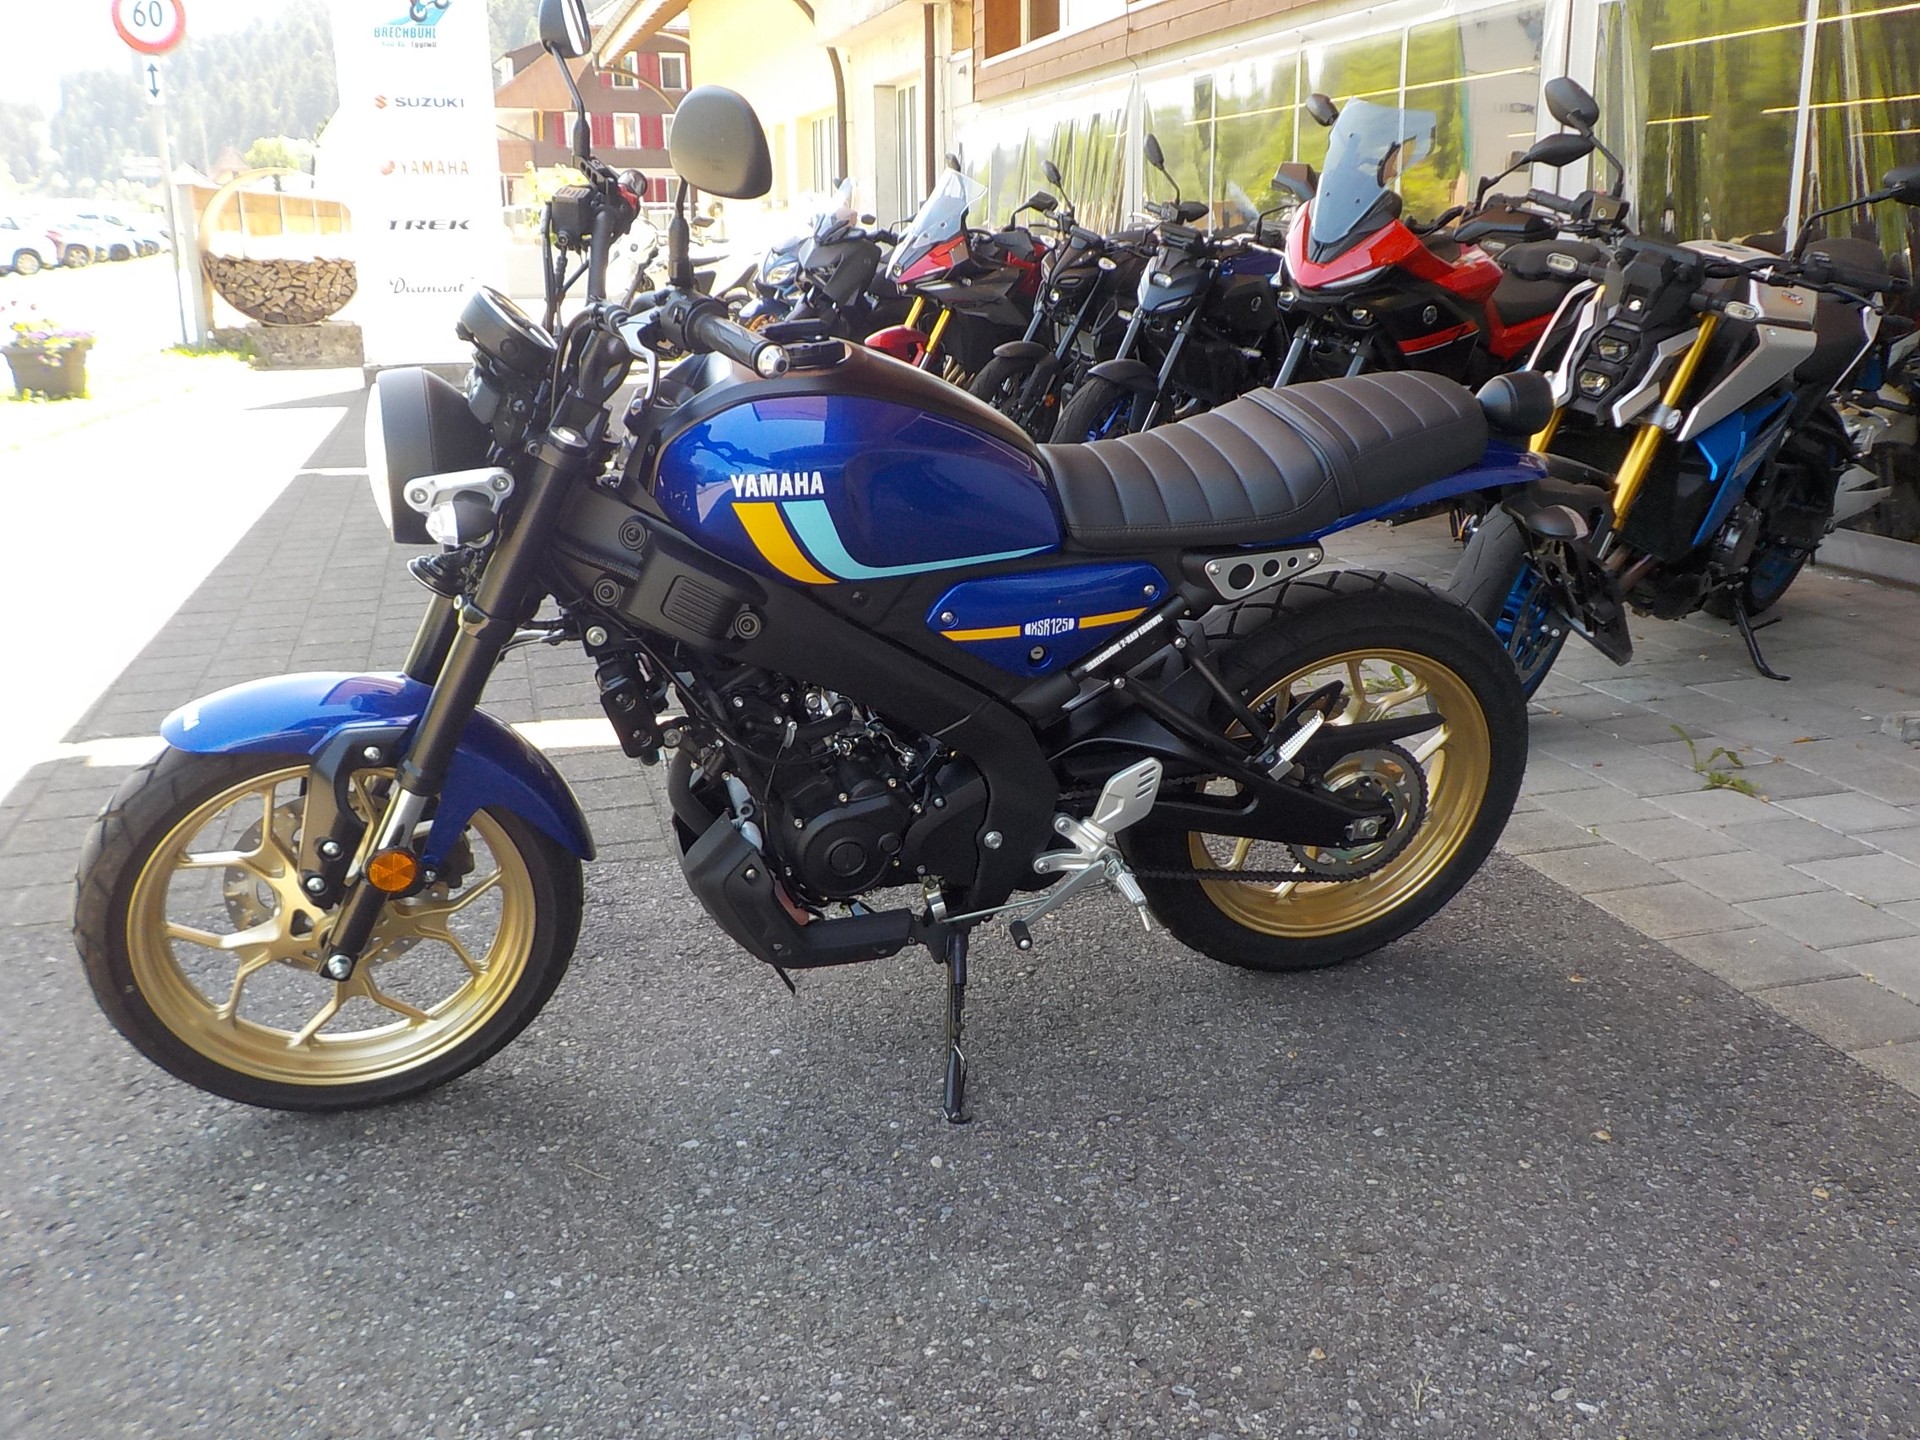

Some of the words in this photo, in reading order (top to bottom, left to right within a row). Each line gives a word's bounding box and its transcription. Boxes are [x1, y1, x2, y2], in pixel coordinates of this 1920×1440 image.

[133, 0, 162, 27] 60
[395, 97, 465, 108] SUZUKI
[401, 160, 469, 175] YAMAHA
[387, 219, 471, 230] TREK
[730, 471, 824, 497] YAMAHA
[1029, 617, 1070, 636] XSR125
